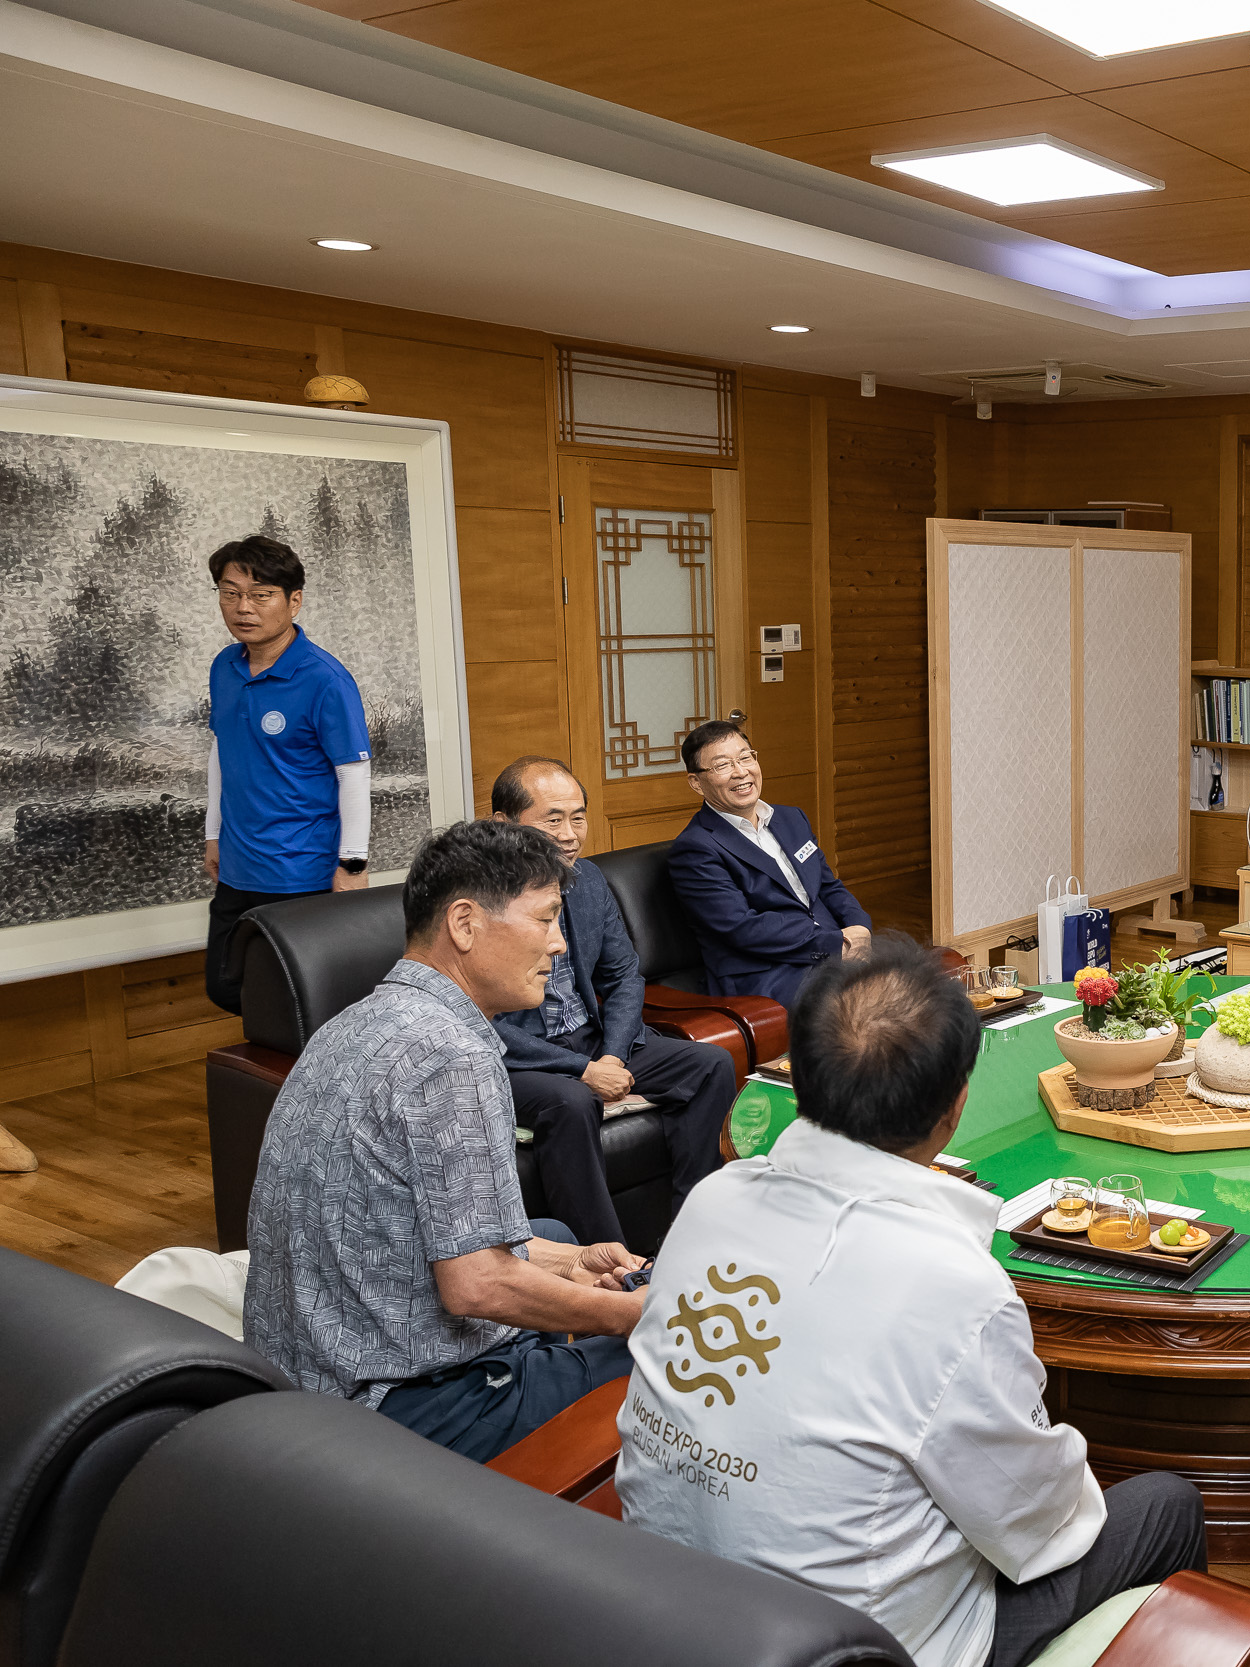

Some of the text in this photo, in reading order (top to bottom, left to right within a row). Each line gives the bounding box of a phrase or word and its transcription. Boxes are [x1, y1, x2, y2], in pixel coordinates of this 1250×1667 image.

[632, 1391, 758, 1483] World EXPO 2030
[677, 1458, 730, 1502] KOREA
